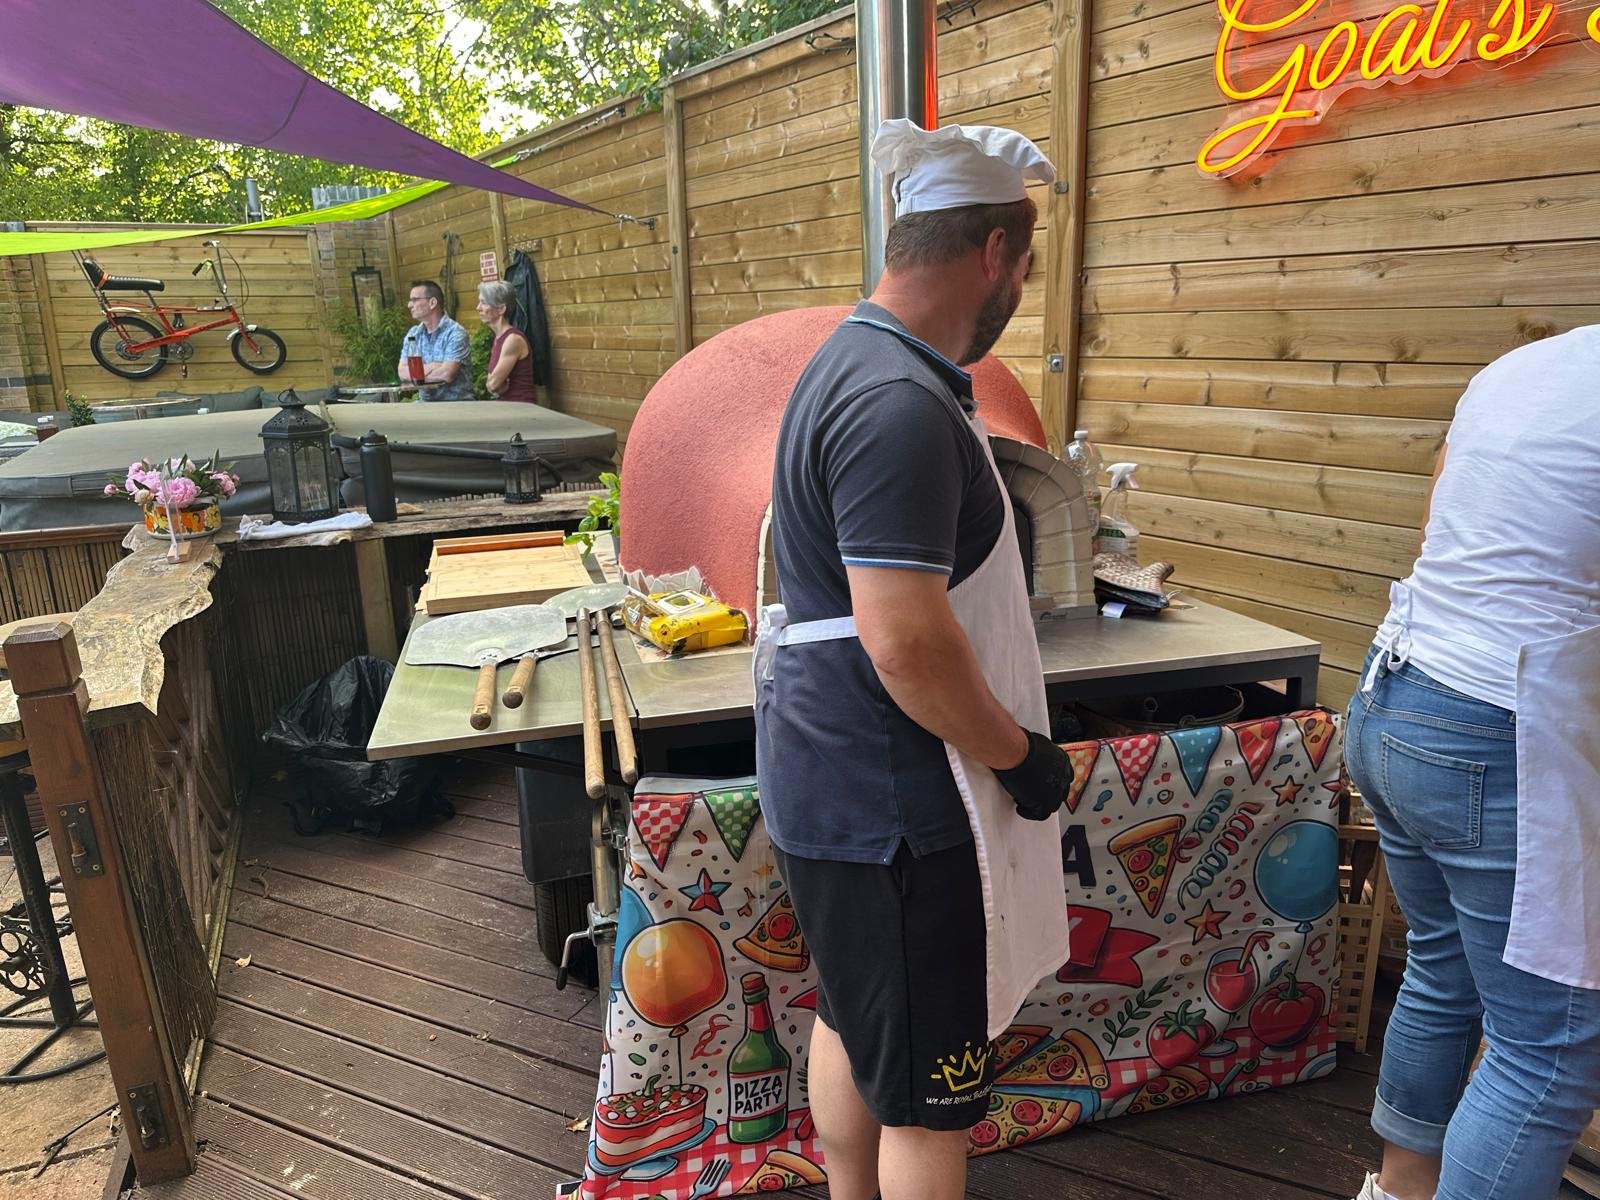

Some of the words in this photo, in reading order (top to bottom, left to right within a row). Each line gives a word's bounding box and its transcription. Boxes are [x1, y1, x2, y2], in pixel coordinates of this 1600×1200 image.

[734, 1075, 783, 1100] PIZZA
[734, 1088, 783, 1114] PARTY
[926, 1097, 939, 1105] WE
[939, 1097, 953, 1105] ARE
